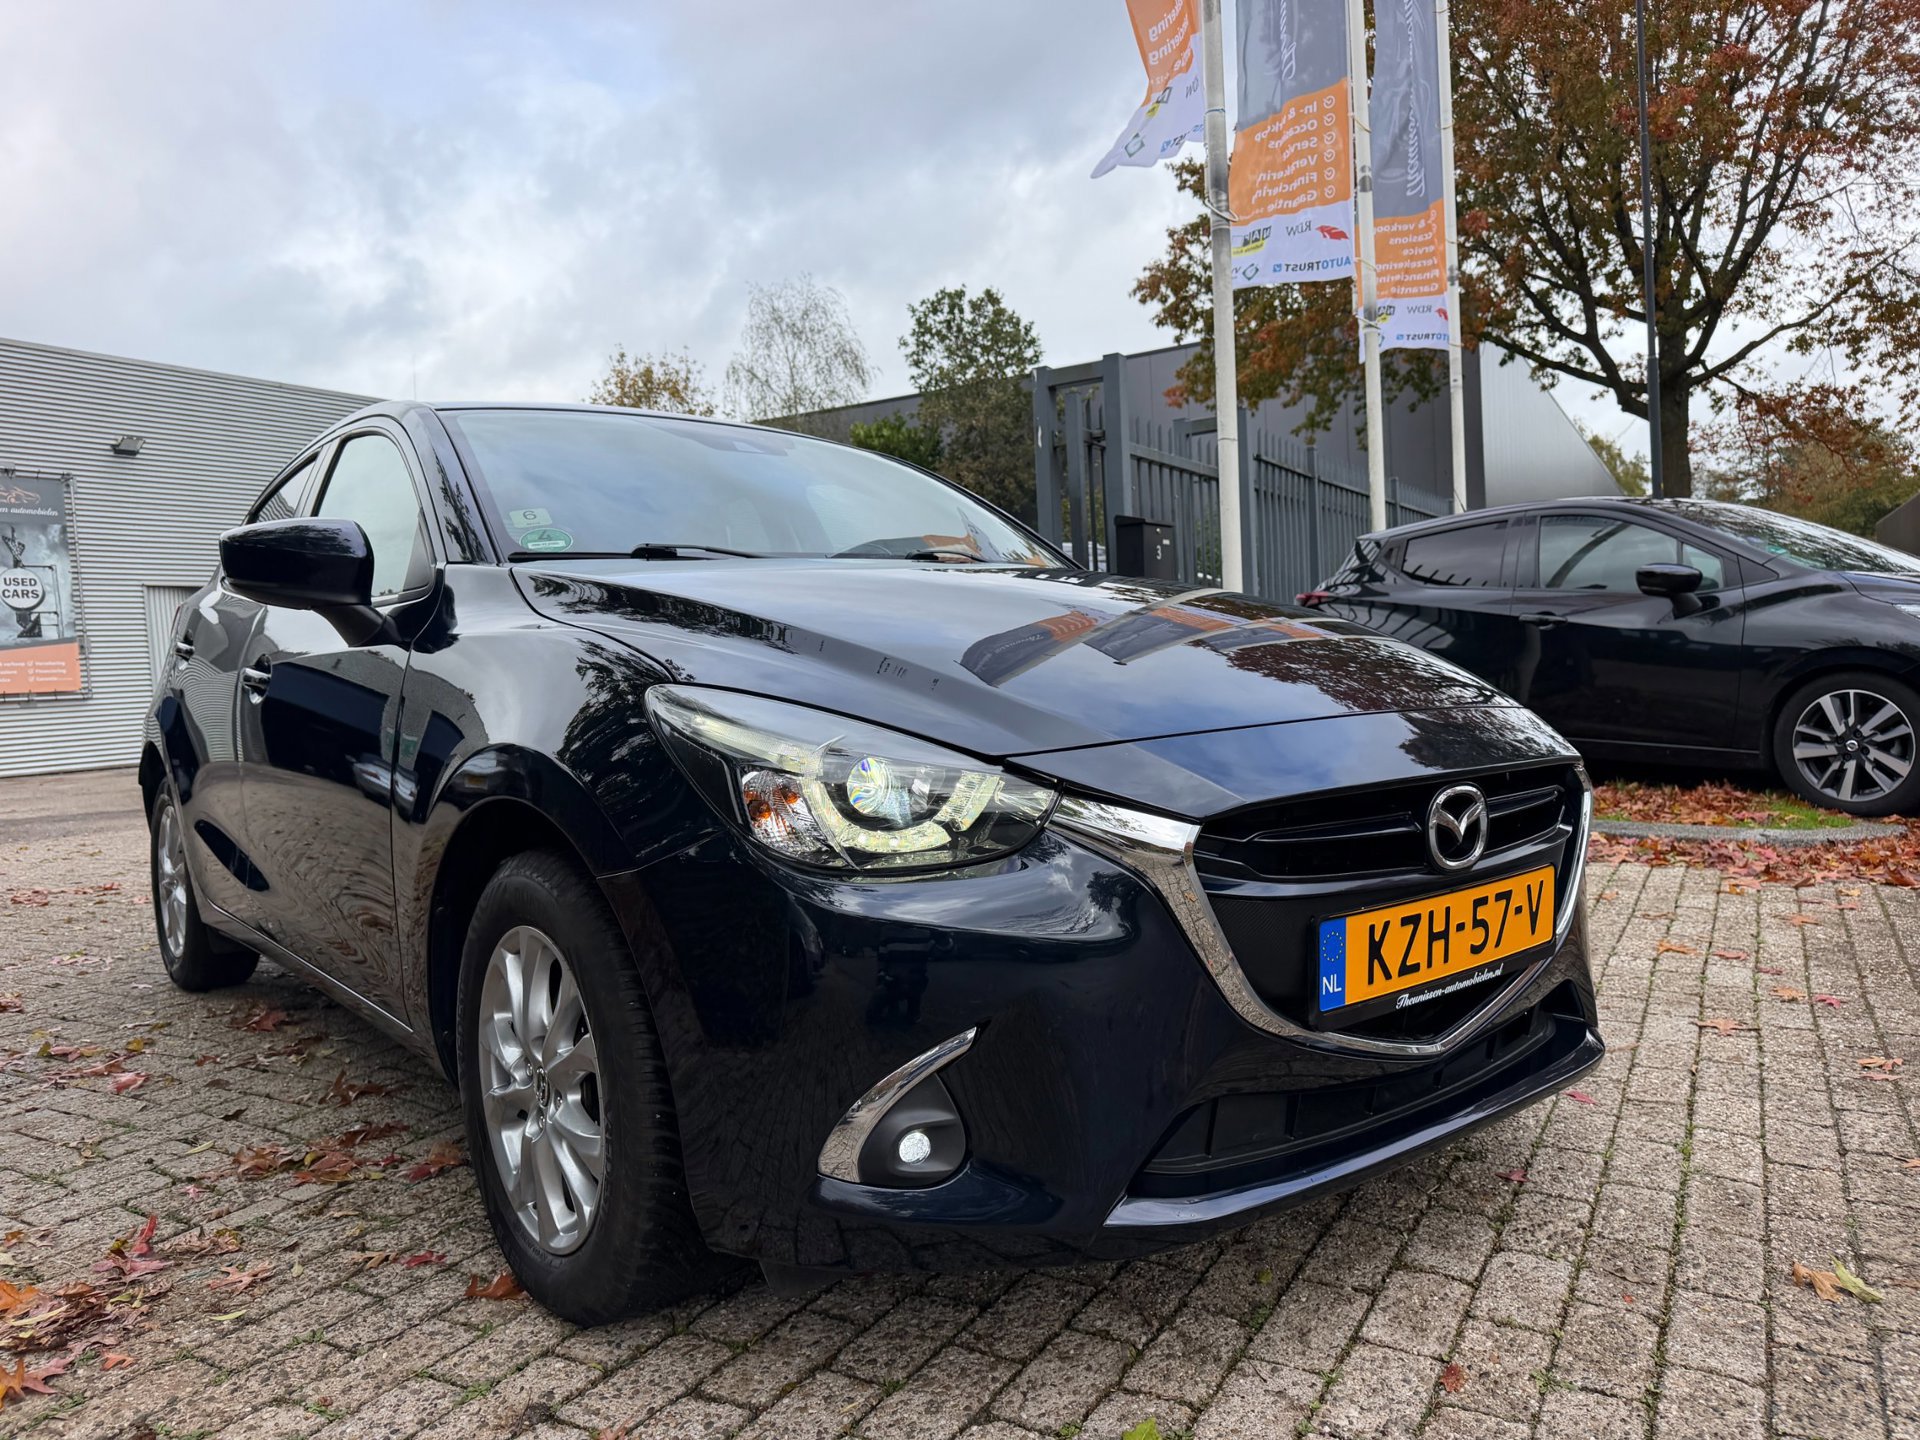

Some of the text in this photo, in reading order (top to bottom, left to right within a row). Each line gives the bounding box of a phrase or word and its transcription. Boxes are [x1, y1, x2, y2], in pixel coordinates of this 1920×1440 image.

[1156, 545, 1162, 560] 3
[3, 577, 37, 587] USED
[2, 589, 40, 599] CARS
[1367, 880, 1544, 986] KZH-57-V
[1322, 974, 1342, 996] NL
[1395, 963, 1504, 1010] Theunissen-automobielen.nl
